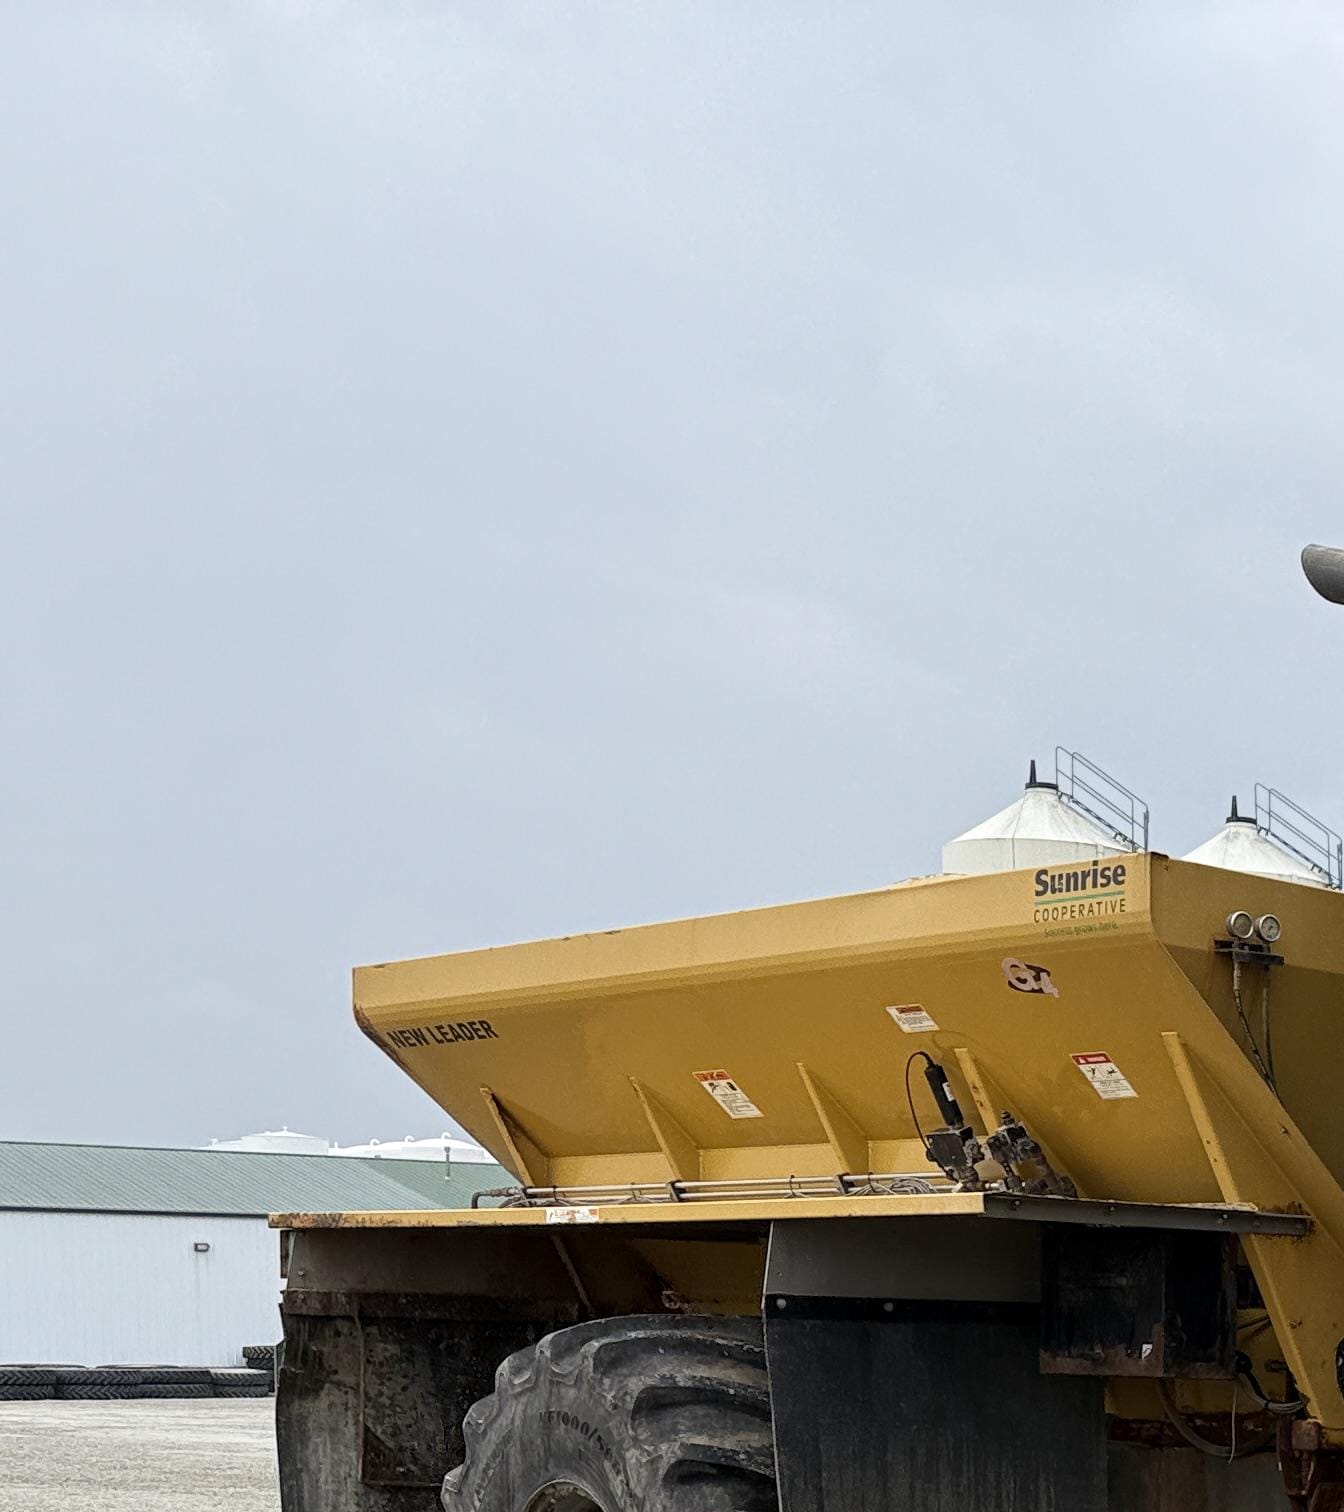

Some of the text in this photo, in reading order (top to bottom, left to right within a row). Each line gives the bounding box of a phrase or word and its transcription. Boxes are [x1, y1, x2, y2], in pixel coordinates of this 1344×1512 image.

[1034, 860, 1126, 896] Sunrise
[1033, 899, 1126, 923] COOPERATIVE
[386, 1020, 500, 1049] NEW LEADER
